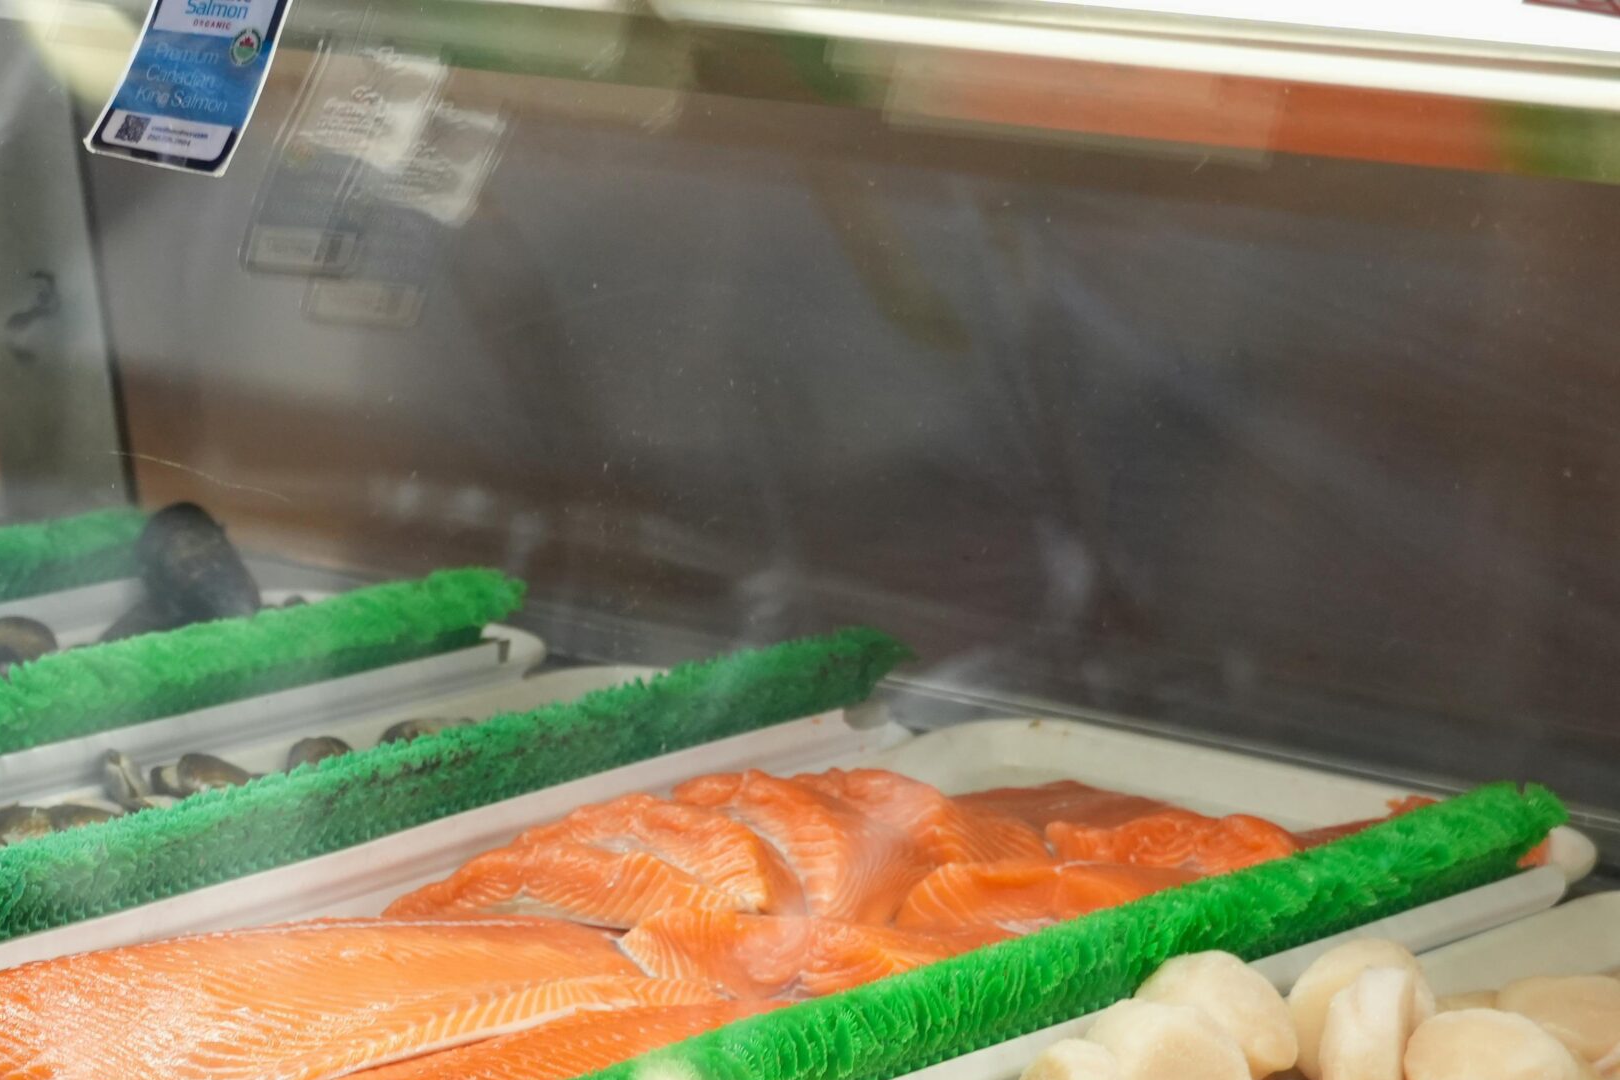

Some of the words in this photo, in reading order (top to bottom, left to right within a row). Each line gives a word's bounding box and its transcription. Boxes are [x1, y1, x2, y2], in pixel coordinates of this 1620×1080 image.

[185, 0, 248, 19] Salmon
[193, 19, 232, 30] ORGANIC
[154, 42, 220, 65] Premium
[146, 63, 217, 88] Canadian
[134, 87, 170, 108] King
[170, 90, 228, 112] Salmon
